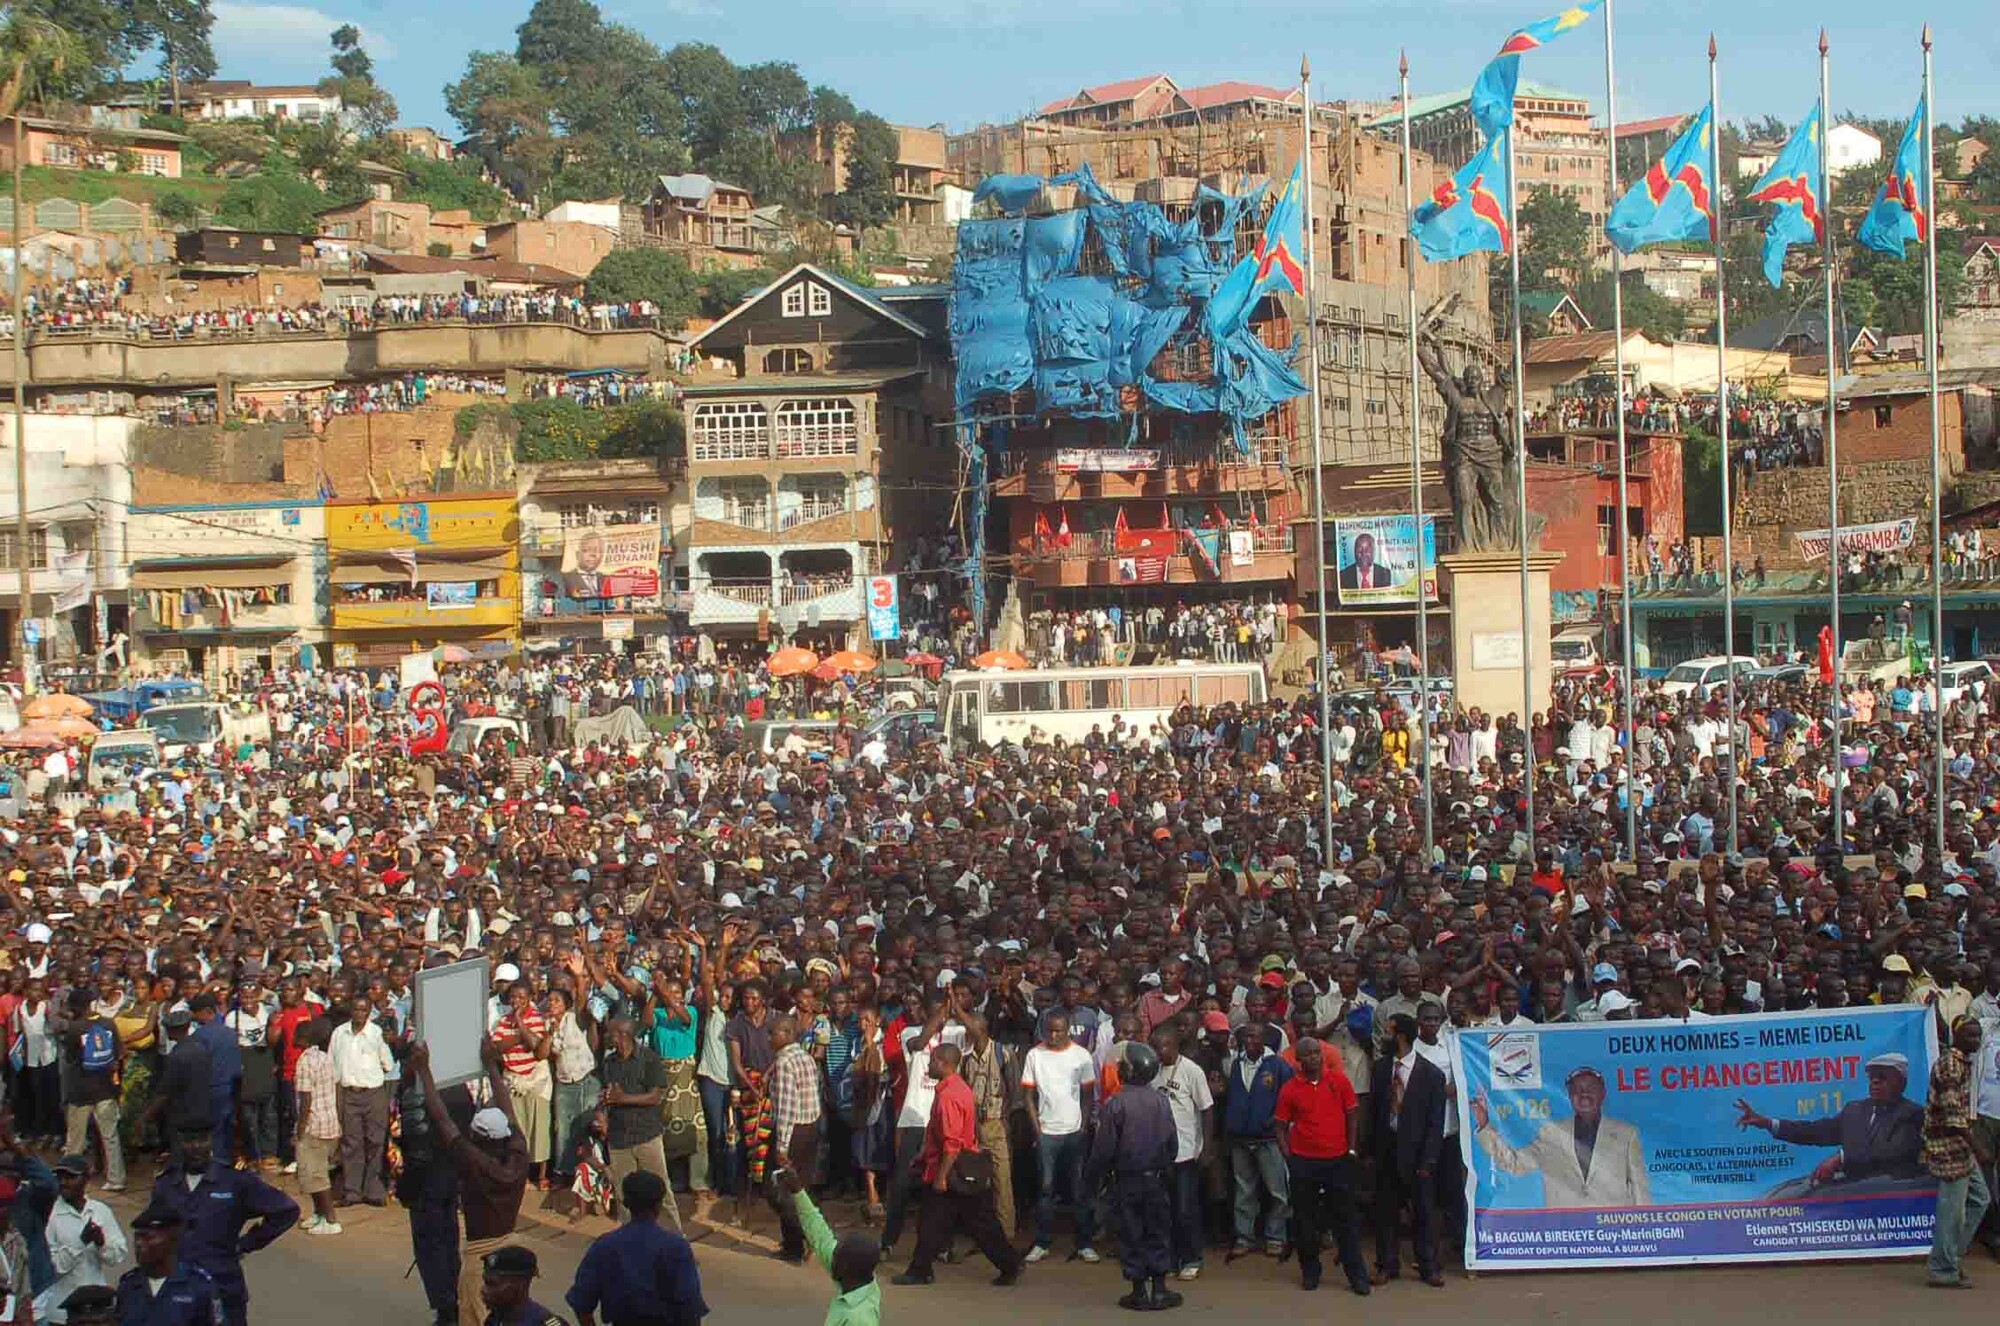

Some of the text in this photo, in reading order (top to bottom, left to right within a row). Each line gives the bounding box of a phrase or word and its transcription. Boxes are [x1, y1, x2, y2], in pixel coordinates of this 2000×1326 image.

[606, 541, 655, 553] MUSHI
[872, 579, 892, 608] 3
[1609, 1036, 1656, 1054] DEUX
[1660, 1031, 1739, 1052] HOMMES
[1759, 1029, 1809, 1047] MEME
[1815, 1023, 1866, 1043] IDEAL
[1617, 1056, 1860, 1092] LE CHANGEMENT
[1820, 1092, 1843, 1114] 11
[1655, 1143, 1787, 1159] AVEC LE SOUTIEN DU PEUPLE
[1778, 1157, 1794, 1167] EST
[1691, 1173, 1755, 1184] IRREVERSIBLE
[1597, 1213, 1648, 1225] SAUVONS
[1651, 1212, 1663, 1222] LE
[1665, 1210, 1706, 1222] CONGO
[1707, 1208, 1722, 1220] EN
[1724, 1207, 1768, 1219] VOTANT
[1746, 1214, 1936, 1236] Etienne TSHISEKEDI WA MULUMBA
[1495, 1231, 1542, 1243] BAGUMA
[1544, 1228, 1595, 1242] BIREKEYE
[1753, 1230, 1934, 1247] CANDIDAT PRESIDENT DE LA REPUBLIQUE
[1491, 1246, 1534, 1256] CANDIDAT
[1536, 1245, 1568, 1255] DEPUTE
[1569, 1244, 1613, 1254] NATIONAL
[1622, 1243, 1658, 1253] BUKAVU
